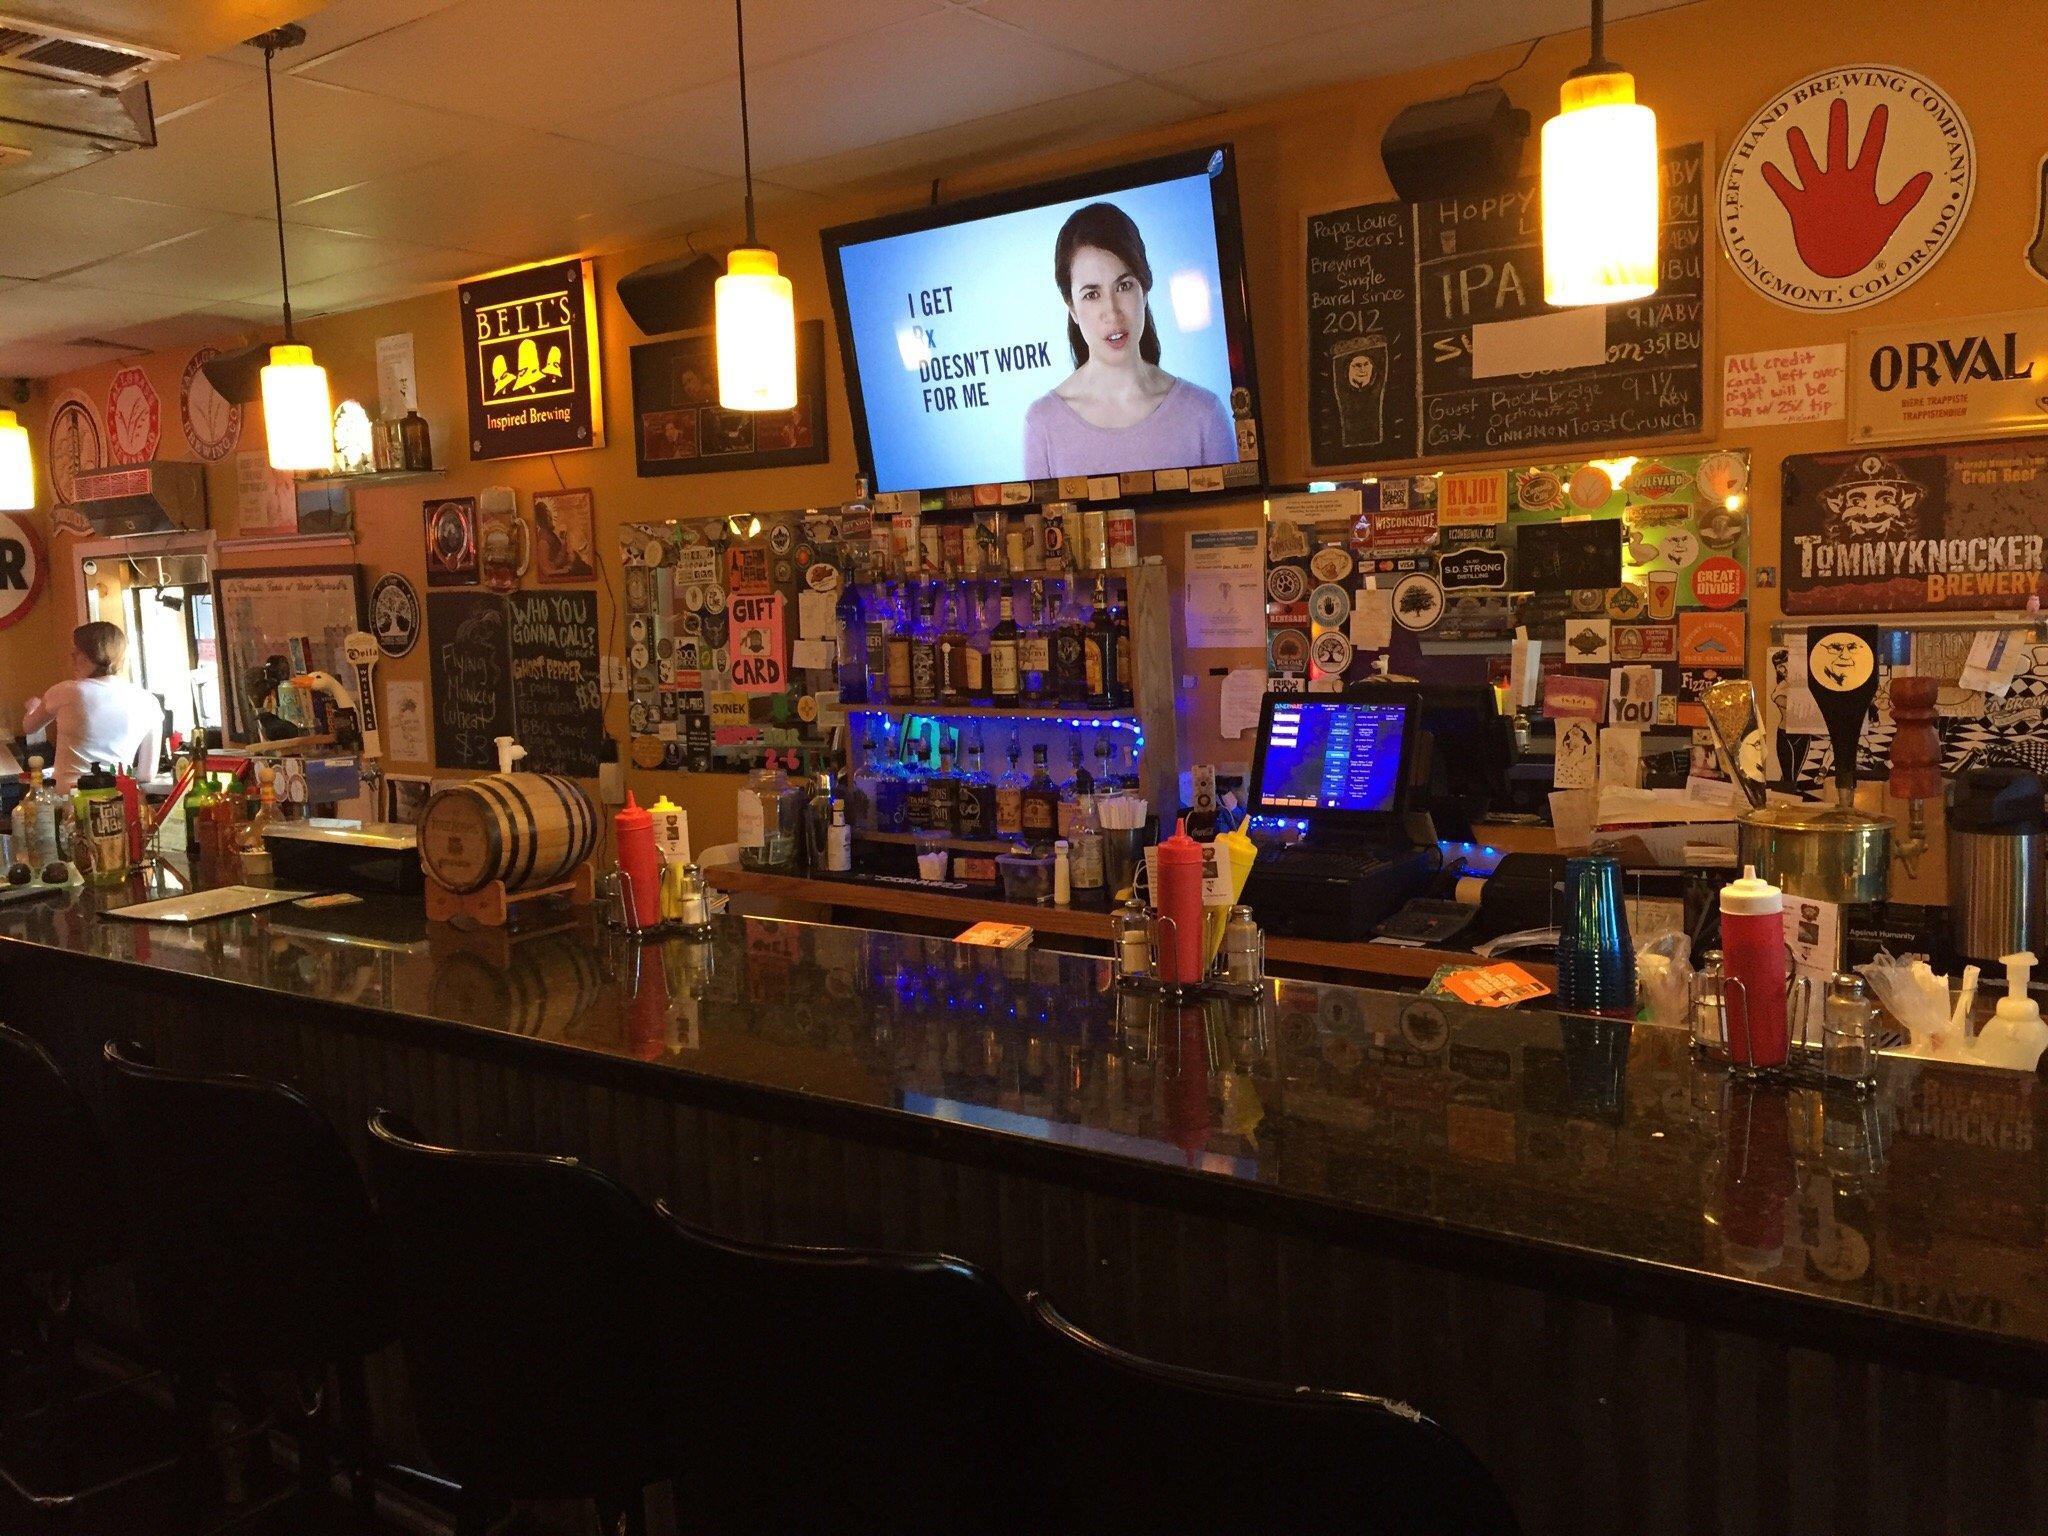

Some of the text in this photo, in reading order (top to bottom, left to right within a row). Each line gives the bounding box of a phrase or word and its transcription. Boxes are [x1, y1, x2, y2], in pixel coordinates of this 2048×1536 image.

[1726, 71, 1966, 222] LEFT HAND BREWING COMPANY
[1313, 212, 1401, 244] Papa Louie
[1344, 226, 1405, 251] Beers!
[1310, 254, 1372, 275] Brewing
[1732, 203, 1957, 304] LONGMONT, COLORADO
[1338, 270, 1386, 292] Single
[1442, 261, 1527, 320] IPA
[908, 286, 953, 318] I GET
[1311, 287, 1406, 309] Barrel since
[475, 296, 571, 341] BELL'S
[1322, 308, 1384, 334] 2012
[918, 341, 1051, 383] DOESN'T WORK
[1727, 351, 1816, 374] All credit
[1868, 332, 2035, 392] ORVAL
[1726, 372, 1768, 389] cards
[1776, 369, 1807, 385] left
[923, 382, 989, 412] FOR ME
[1726, 381, 1827, 406] night will be
[486, 407, 571, 431] Inspired Brewing
[1429, 397, 1478, 421] Guest
[1428, 425, 1471, 446] Cask
[1570, 414, 1618, 436] Toast
[1619, 405, 1696, 432] Crunch
[1444, 563, 1502, 574] S.D. STRONG
[1794, 534, 2045, 579] TOMMYKNOCKER
[1697, 569, 1736, 583] GREAT
[1697, 582, 1736, 595] DIVIDE
[1927, 571, 2042, 604] BREWERY
[511, 597, 587, 625] WHO YOU
[732, 598, 777, 624] GIFT
[513, 623, 596, 649] GONNA CALL?
[441, 642, 488, 686] Flying
[546, 658, 586, 683] PEPPER
[732, 658, 780, 685] CARD
[360, 669, 369, 704] WHITE
[713, 703, 746, 714] SYNEK
[1613, 698, 1653, 723] YOU
[455, 730, 490, 765] $3
[1849, 928, 1916, 940] Against Humanity
